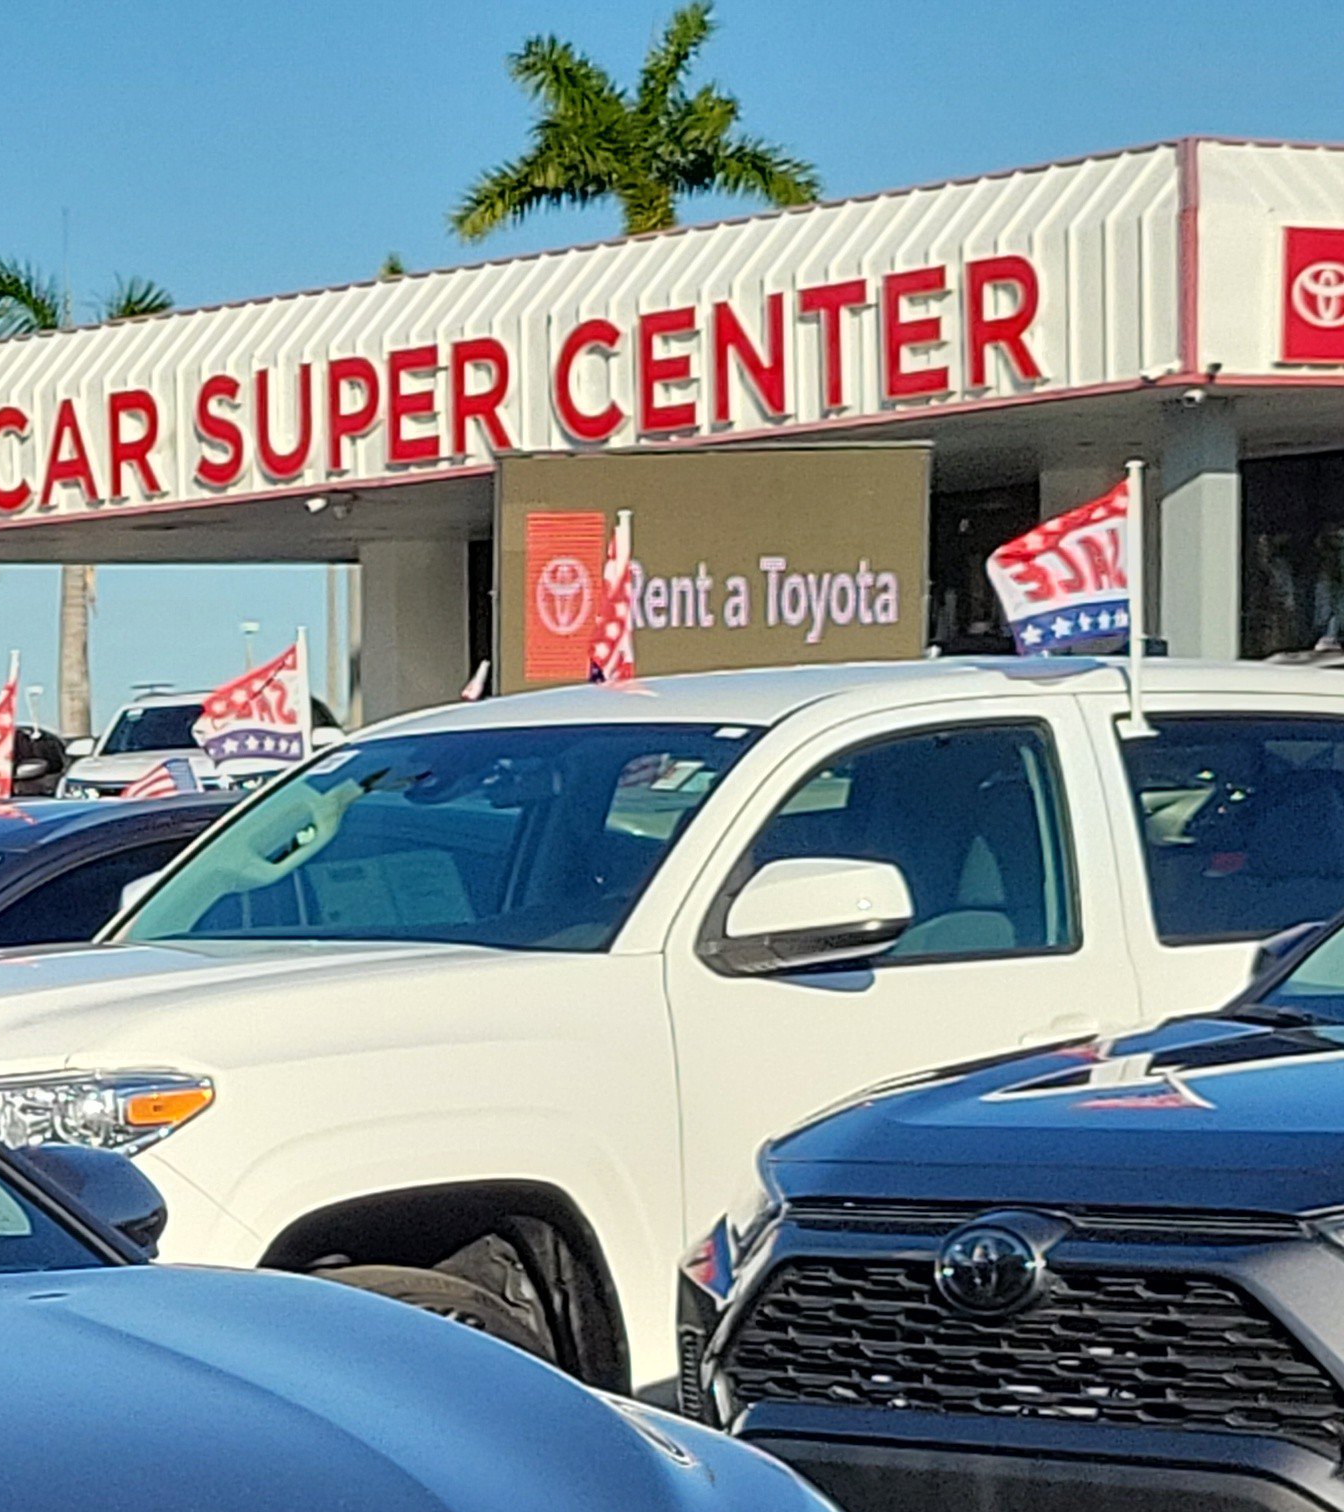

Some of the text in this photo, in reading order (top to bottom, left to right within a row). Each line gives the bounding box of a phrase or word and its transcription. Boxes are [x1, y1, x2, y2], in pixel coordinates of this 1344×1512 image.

[195, 337, 513, 488] SUPER
[553, 255, 1044, 442] CENTER
[723, 574, 750, 629] a
[759, 556, 900, 644] Toyota
